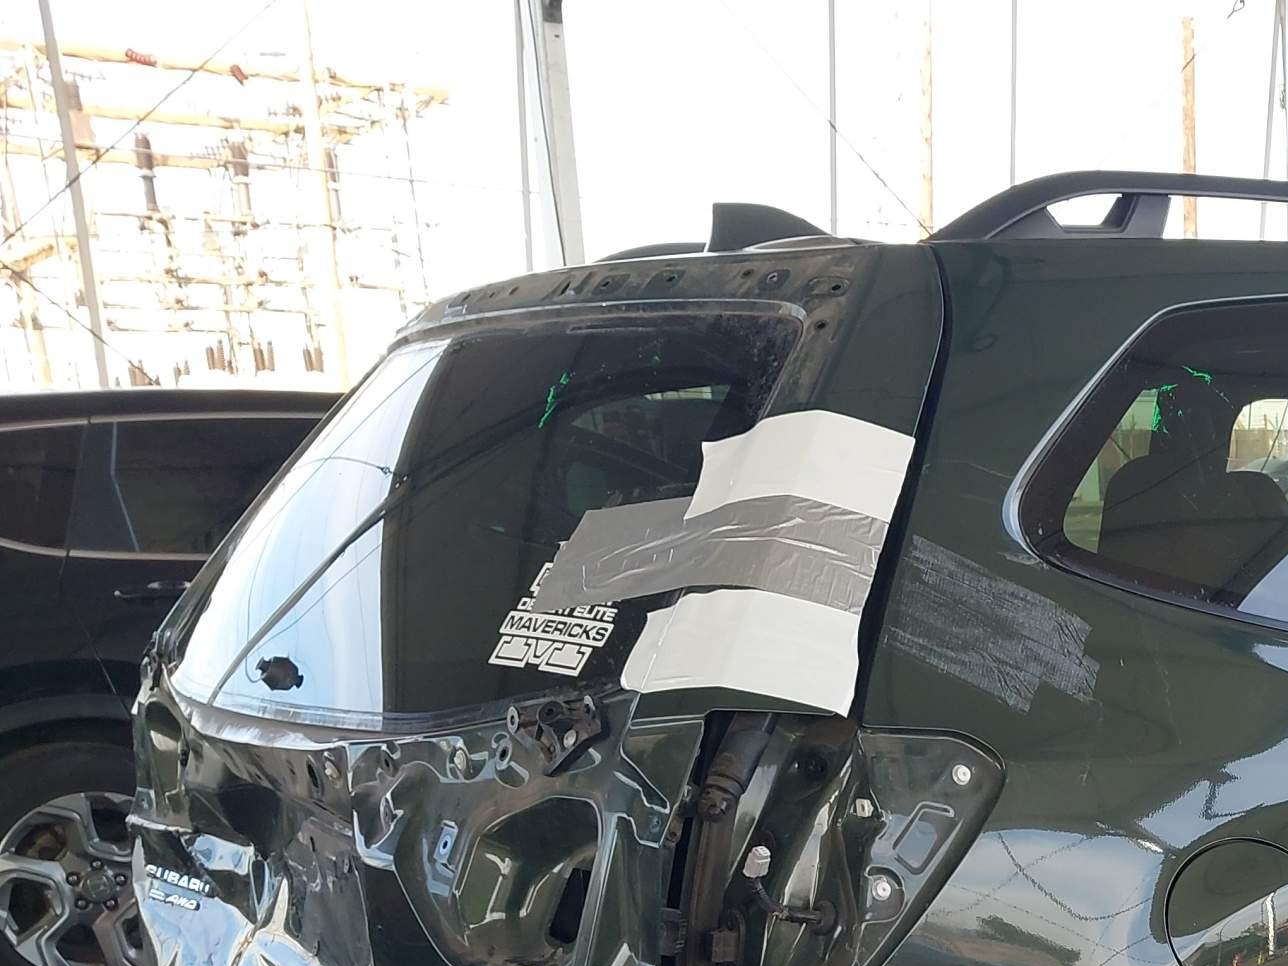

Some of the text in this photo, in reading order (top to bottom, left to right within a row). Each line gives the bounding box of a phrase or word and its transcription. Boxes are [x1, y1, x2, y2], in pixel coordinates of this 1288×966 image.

[572, 604, 619, 623] ELITE
[502, 614, 610, 643] MAVERICKS
[145, 863, 211, 894] SUBARU
